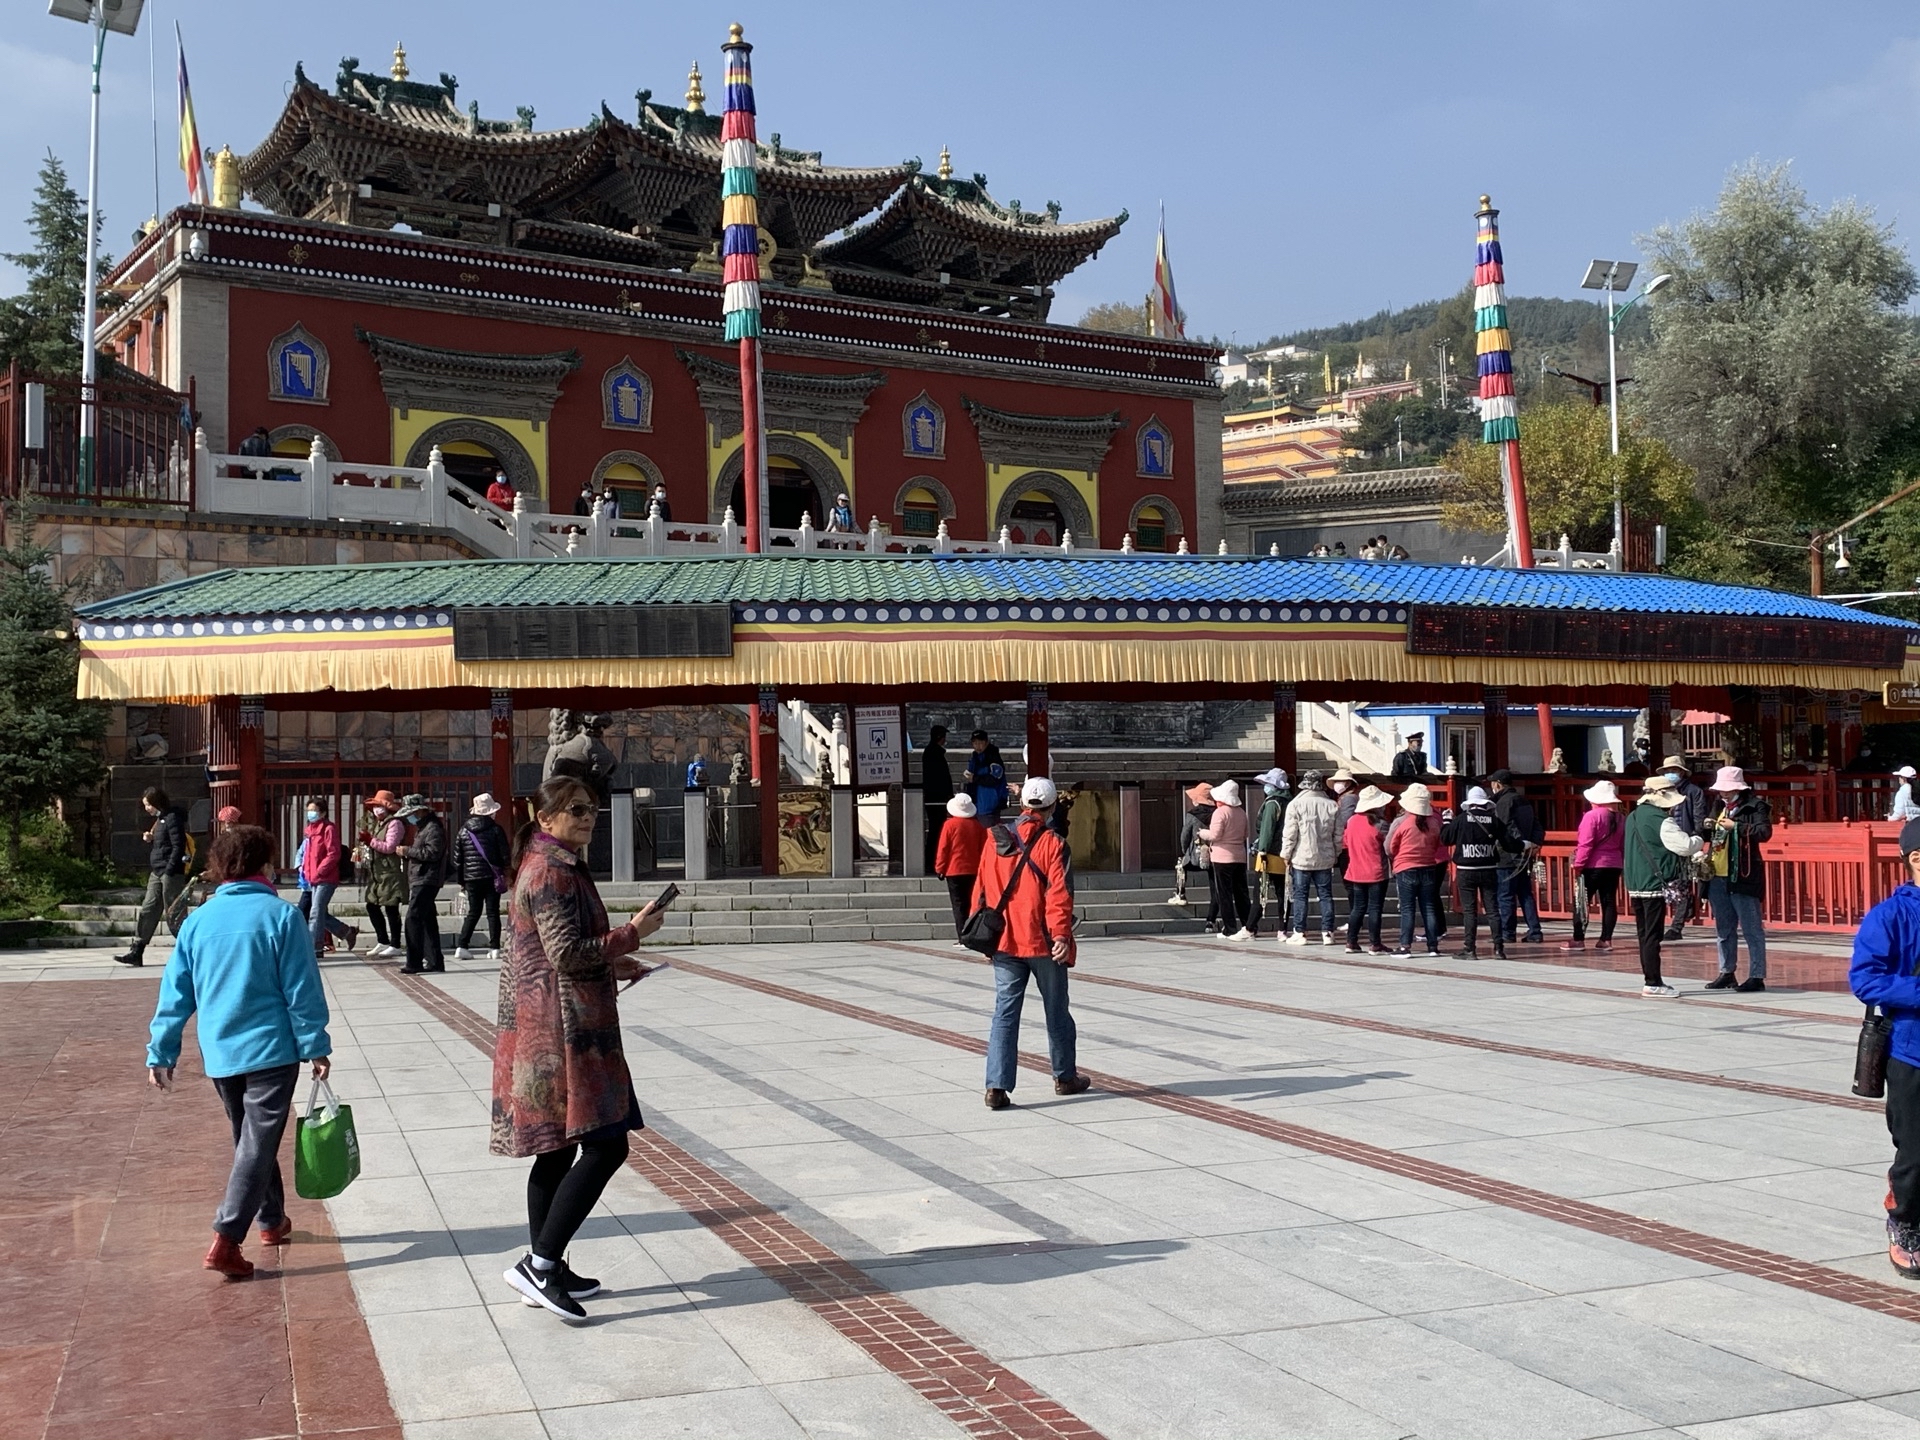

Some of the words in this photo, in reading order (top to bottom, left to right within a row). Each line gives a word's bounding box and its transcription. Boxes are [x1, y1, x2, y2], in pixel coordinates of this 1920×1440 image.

[859, 751, 900, 761] 中山门入口
